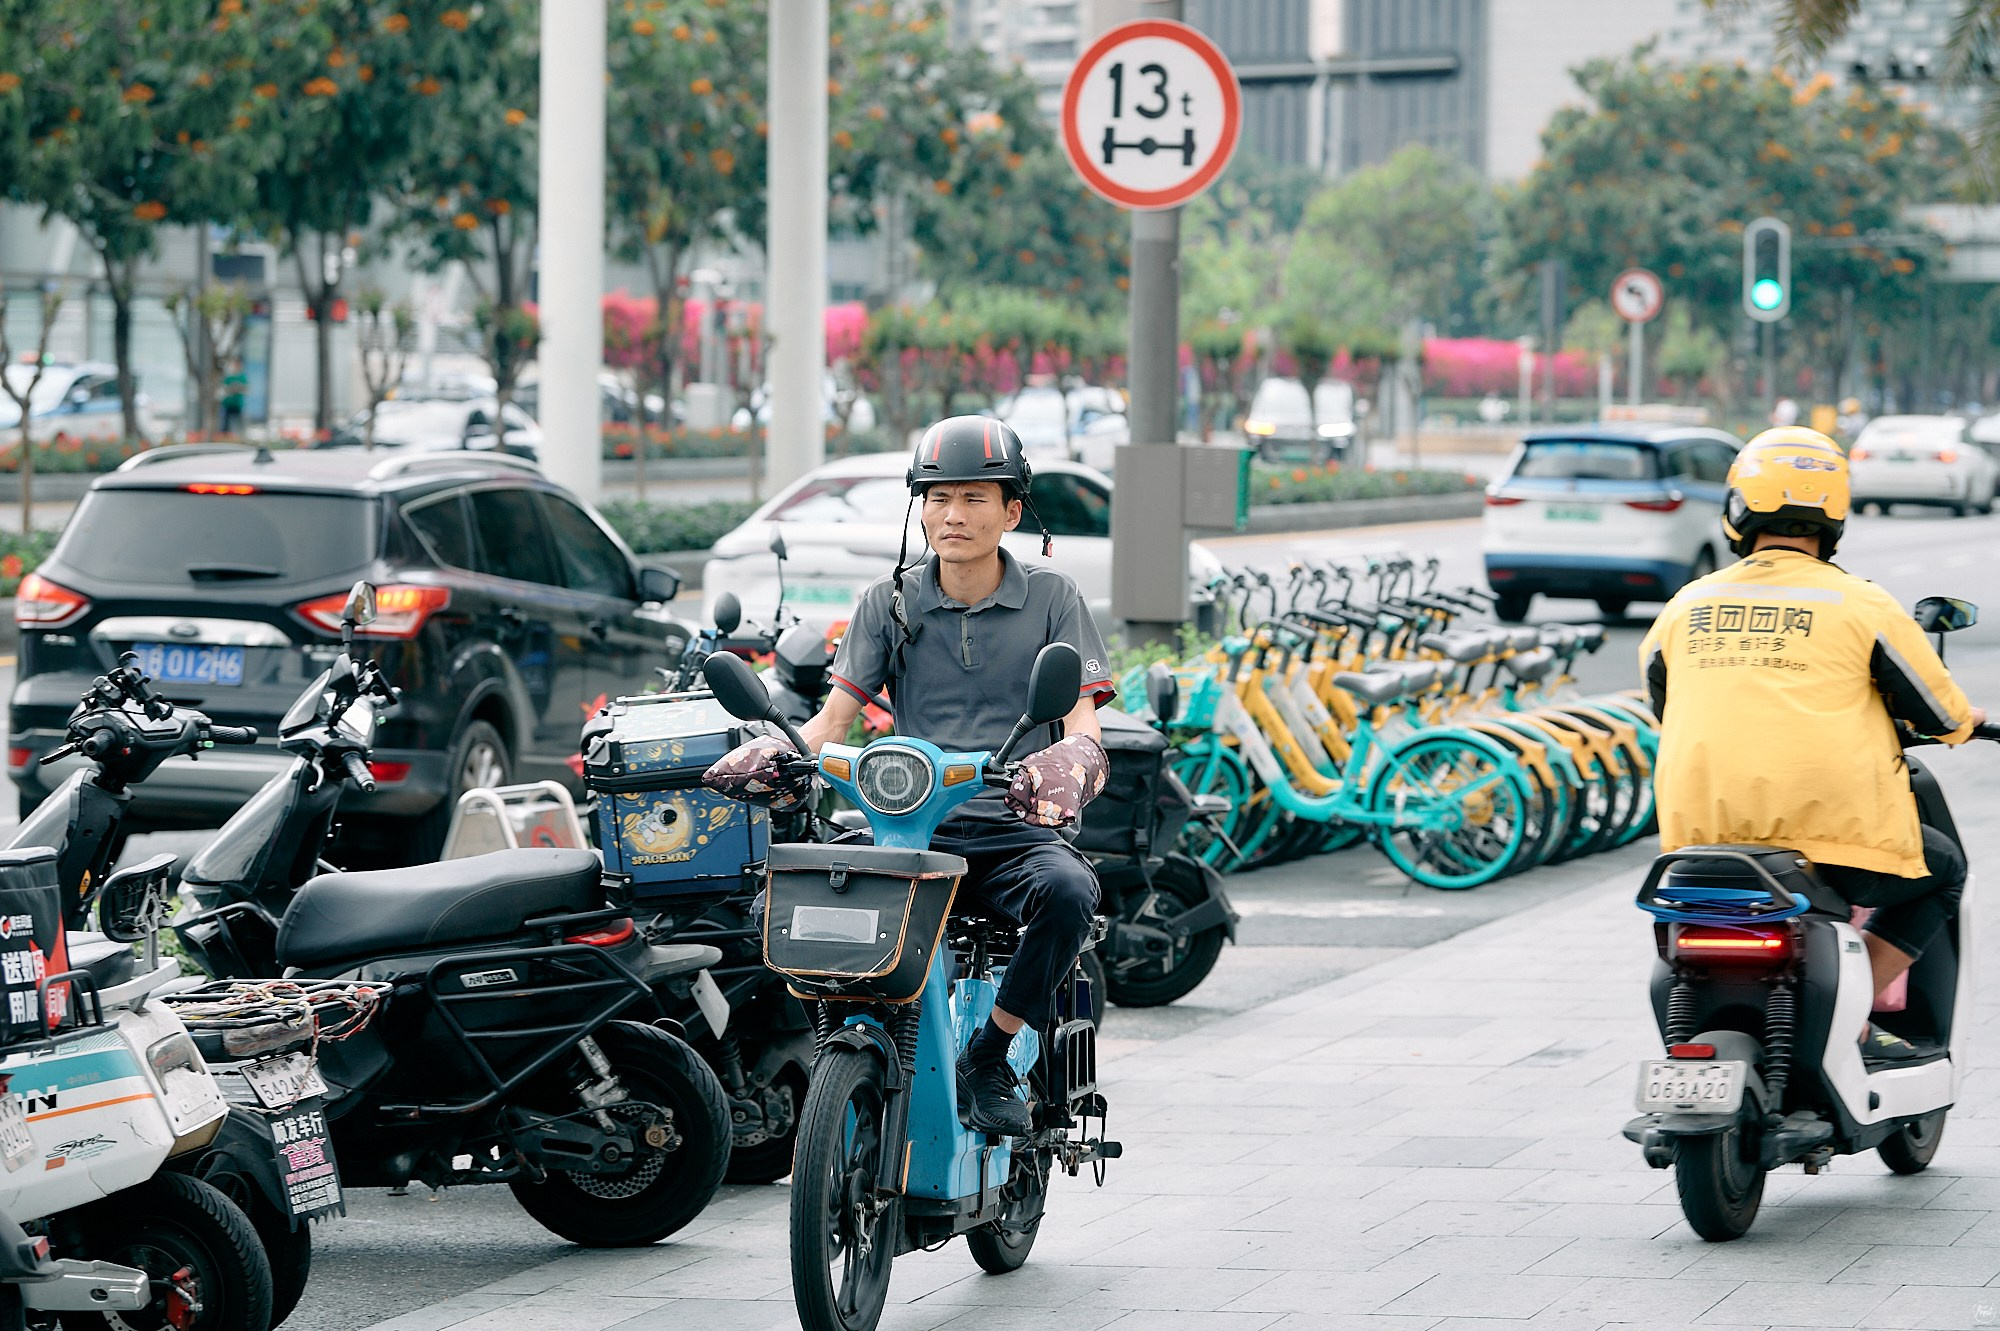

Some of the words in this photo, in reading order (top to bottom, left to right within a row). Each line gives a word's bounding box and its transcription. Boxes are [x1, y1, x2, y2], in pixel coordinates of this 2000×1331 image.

[1688, 604, 1813, 637] 美团团购
[631, 852, 690, 865] SPACEMAN
[8, 987, 67, 1024] 用顺同城
[1648, 1081, 1730, 1100] 063A20
[270, 1110, 323, 1145] 顺发车行
